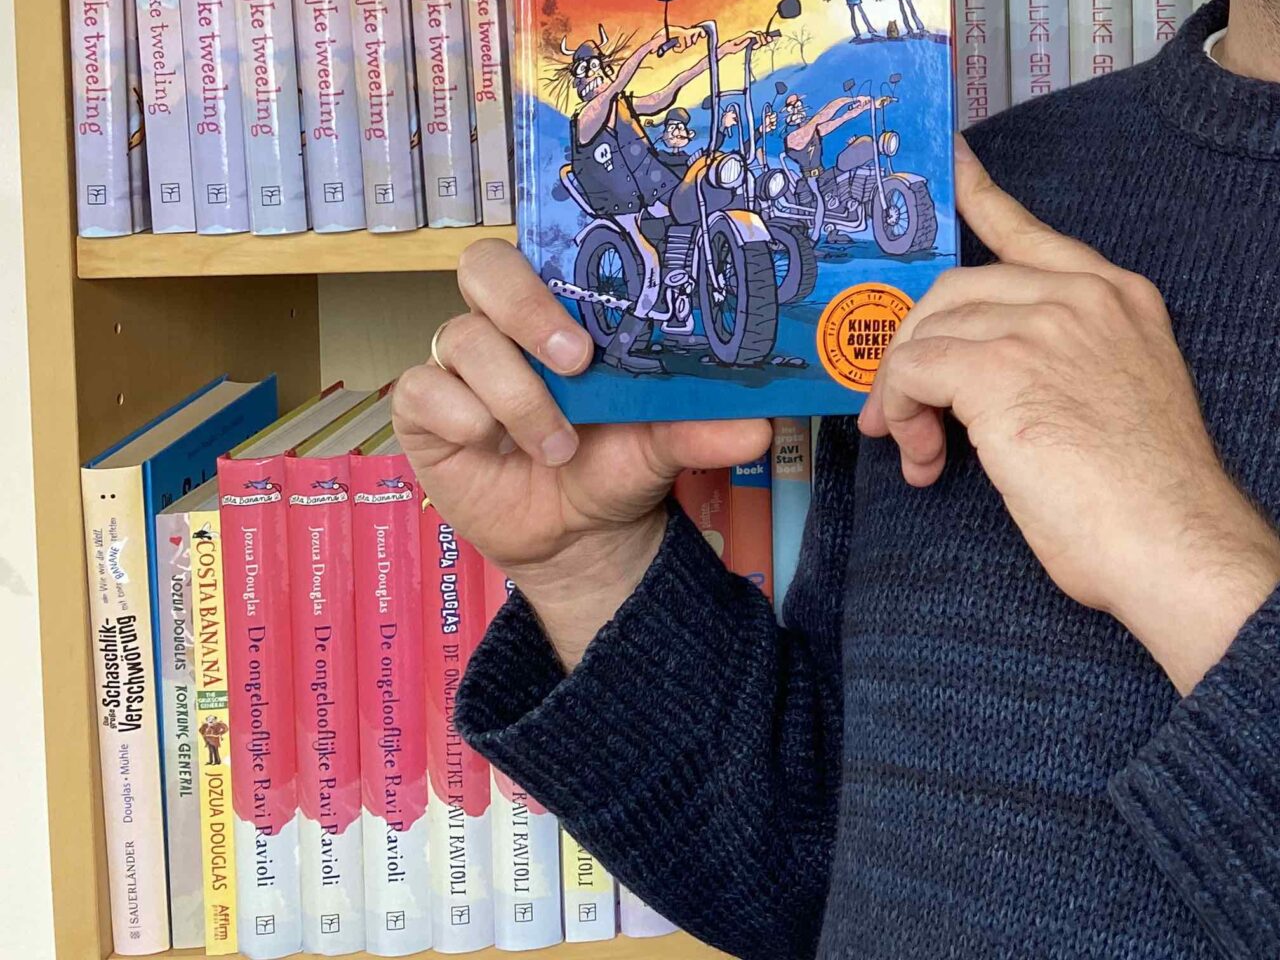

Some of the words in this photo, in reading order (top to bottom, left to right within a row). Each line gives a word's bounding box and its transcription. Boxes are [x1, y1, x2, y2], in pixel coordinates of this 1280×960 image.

[79, 32, 112, 135] tweeling
[475, 19, 501, 102] tweeling
[848, 320, 896, 332] KINDER
[736, 465, 763, 475] boek
[776, 455, 804, 464] Start
[780, 445, 799, 454] AVI
[241, 526, 258, 561] Jozua
[196, 540, 218, 603] COSTA
[243, 564, 259, 617] Douglas
[99, 618, 121, 708] Schaschlik-
[173, 619, 186, 670] DOUGLAS
[199, 607, 223, 688] BANANA
[248, 626, 266, 653] De
[117, 615, 145, 733] Verschwörung
[244, 658, 272, 772] ongelooflijke
[120, 743, 130, 775] Mühle
[178, 743, 193, 798] GENERAL
[121, 783, 134, 824] Douglas
[205, 773, 225, 818] JOZUA
[253, 779, 272, 818] Ravi
[210, 822, 228, 891] DOUGLAS
[255, 826, 276, 888] Ravioli
[125, 841, 139, 925] SAUERLÄNDER
[218, 904, 229, 940] Affirm
